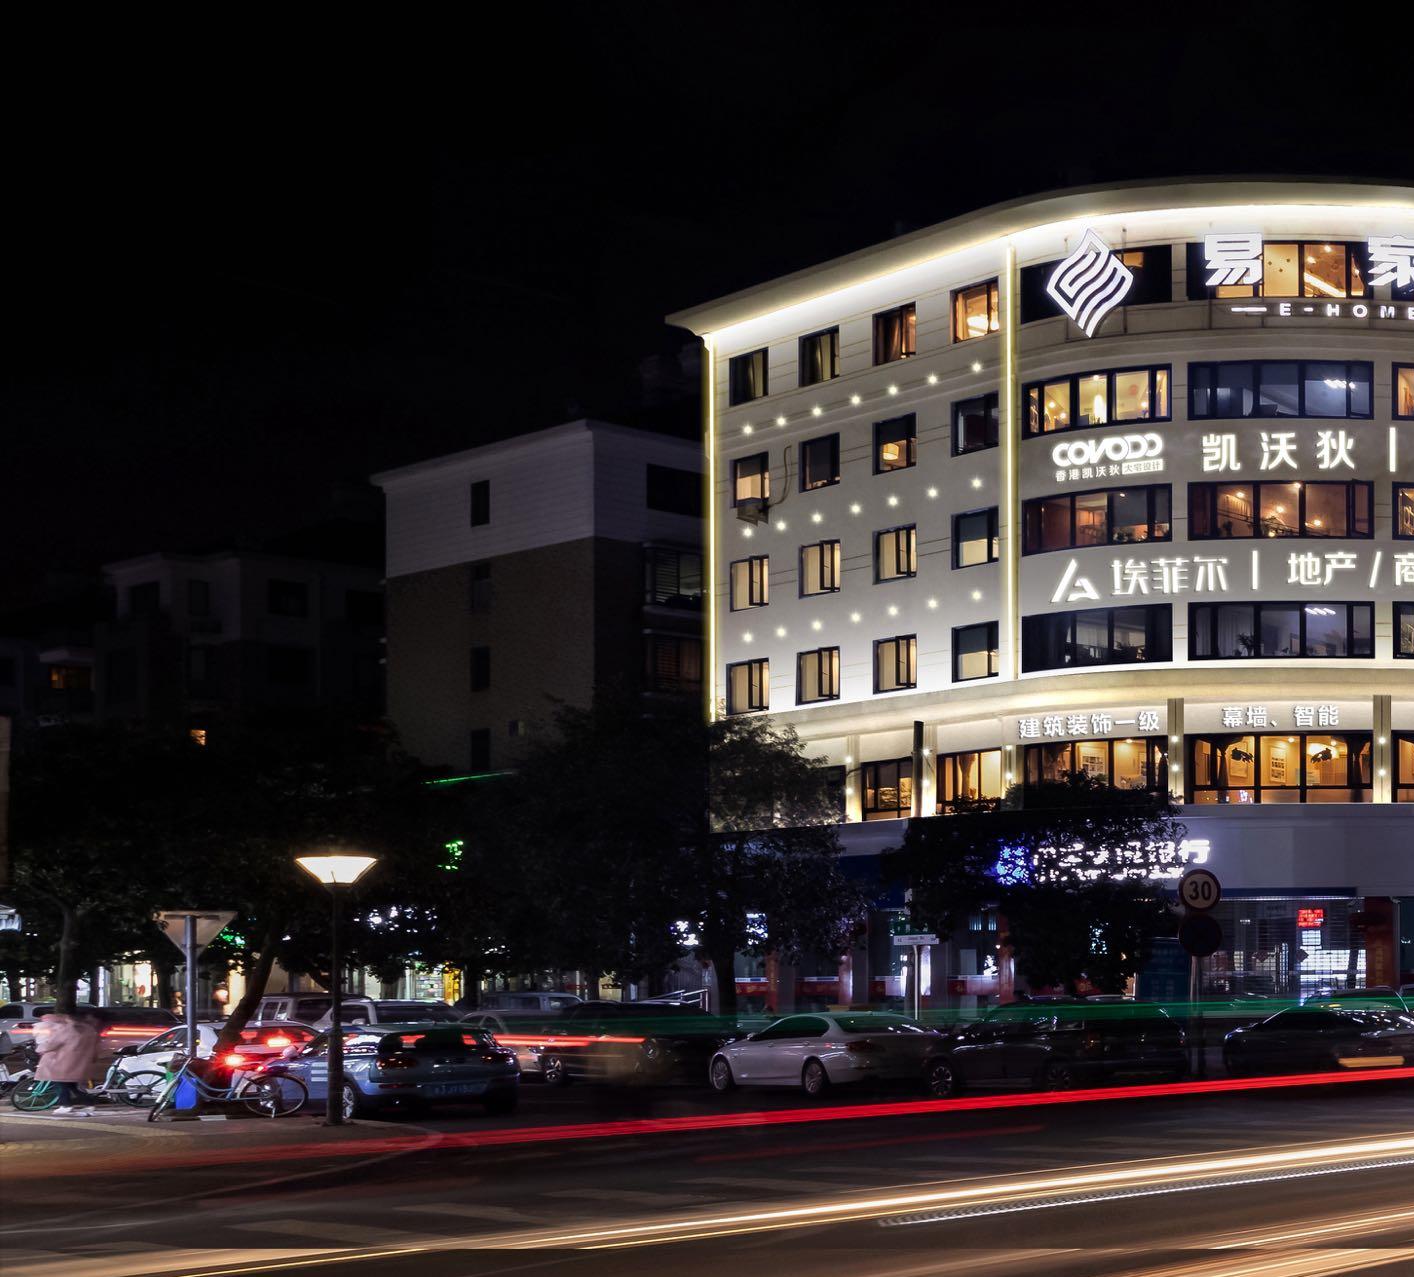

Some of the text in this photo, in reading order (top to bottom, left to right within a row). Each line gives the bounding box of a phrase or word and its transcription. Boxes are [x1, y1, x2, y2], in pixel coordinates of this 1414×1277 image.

[1201, 430, 1355, 472] 凯沃狄
[1055, 463, 1120, 482] 香港凯沃狄
[1111, 555, 1228, 596] 埃菲尔
[1287, 551, 1357, 587] 地产
[1019, 710, 1160, 739] 建筑装饰一级
[1222, 705, 1340, 728] 幕墙、智能
[1188, 880, 1212, 901] 30
